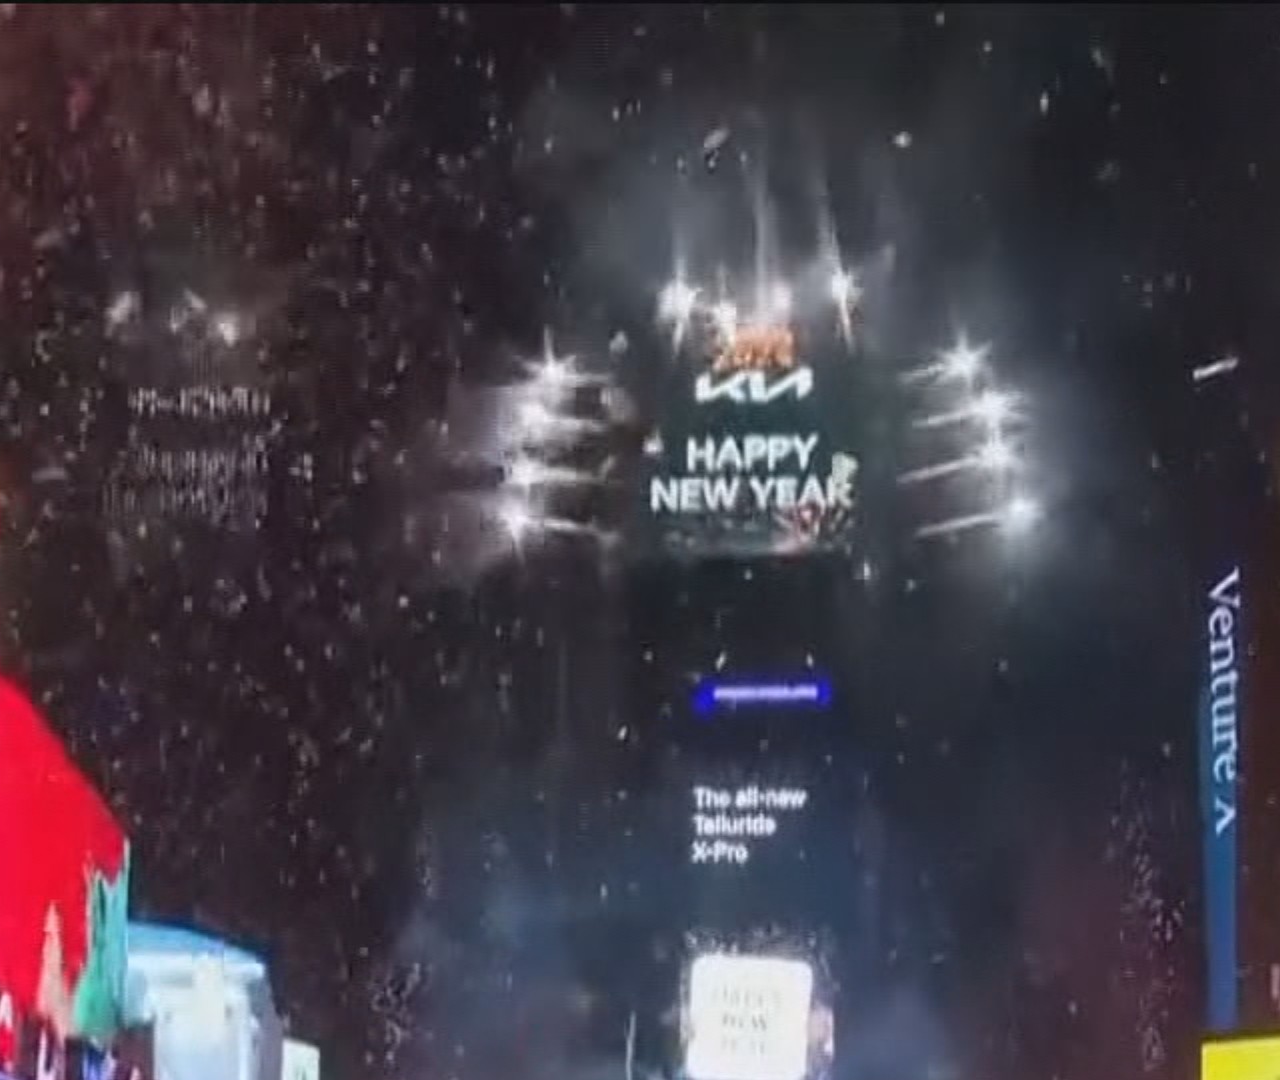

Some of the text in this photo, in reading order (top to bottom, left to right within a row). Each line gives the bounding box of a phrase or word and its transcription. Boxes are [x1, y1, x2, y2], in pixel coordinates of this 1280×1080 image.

[686, 433, 819, 472] HAPPY
[649, 476, 738, 513] NEW
[1209, 565, 1241, 783] Venture
[693, 785, 732, 809] The
[693, 812, 777, 837] Telluride
[691, 839, 749, 865] X-Pro
